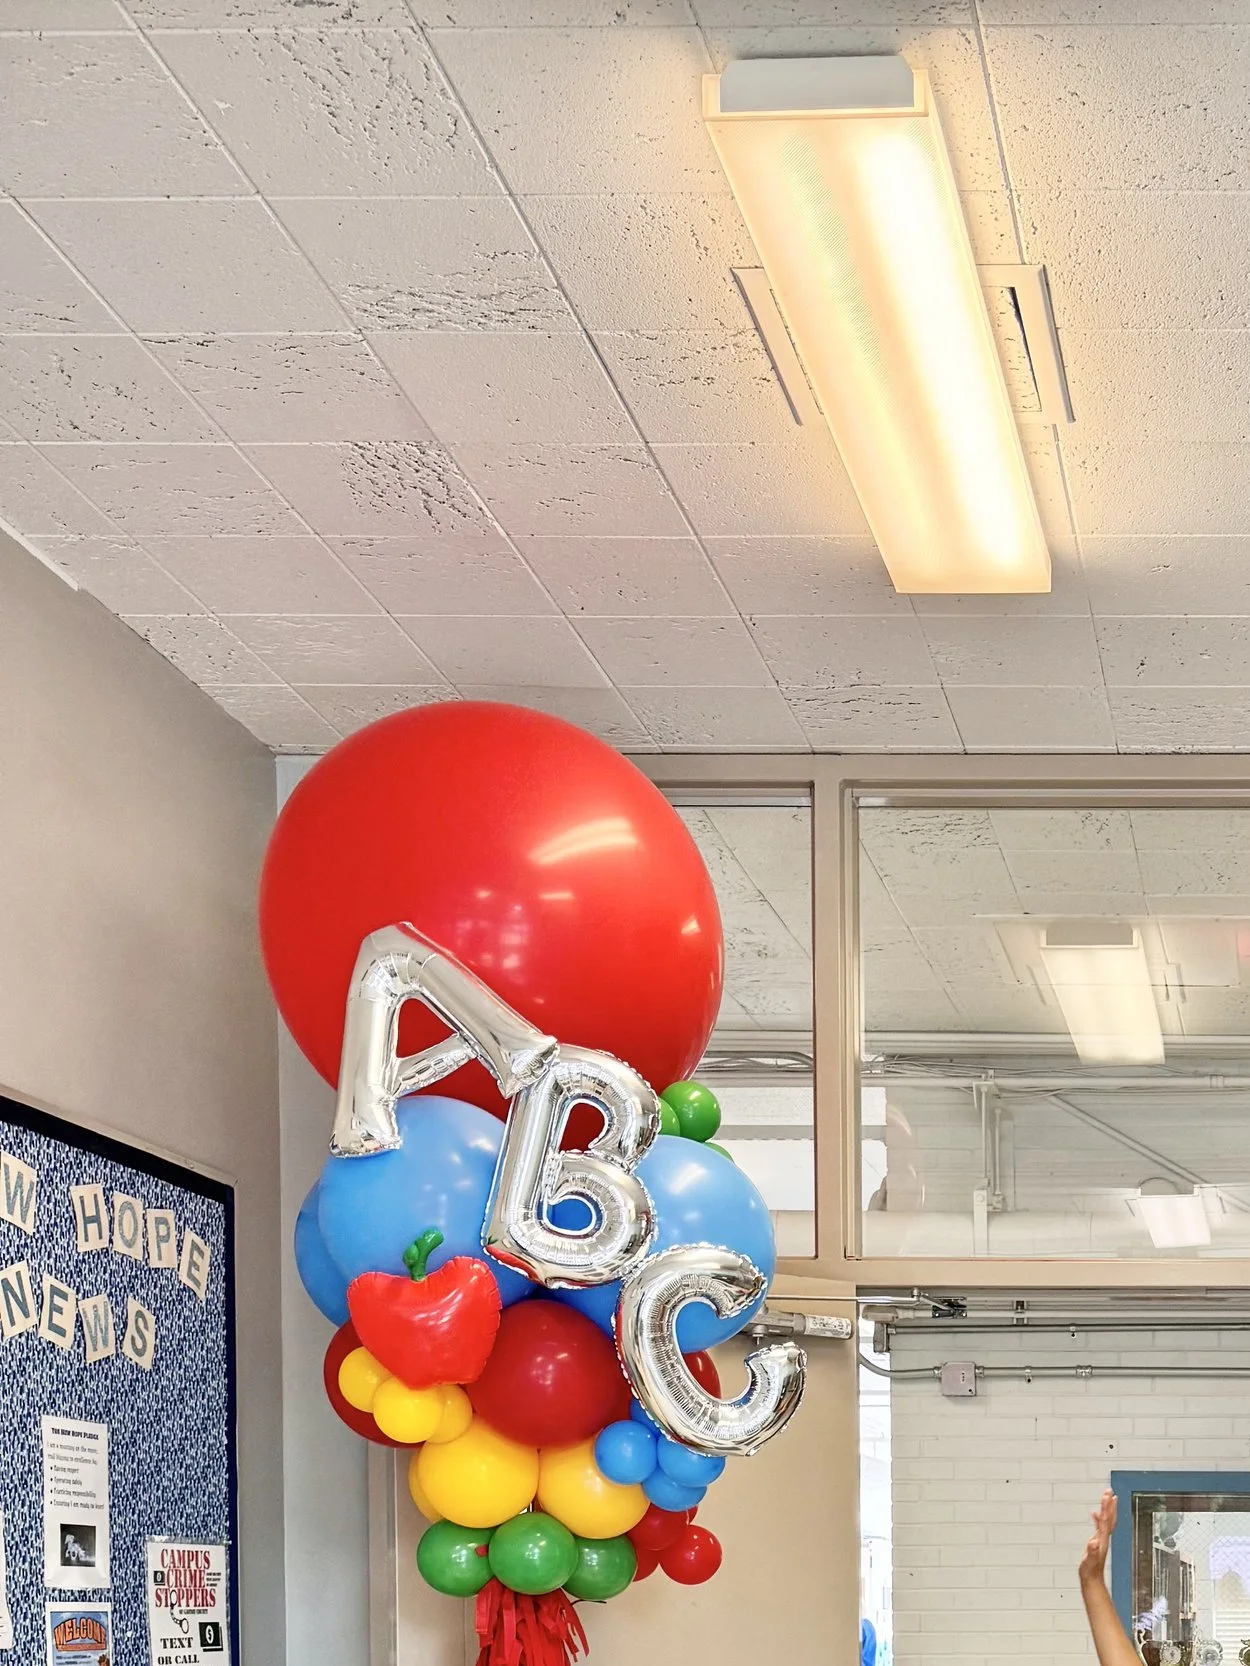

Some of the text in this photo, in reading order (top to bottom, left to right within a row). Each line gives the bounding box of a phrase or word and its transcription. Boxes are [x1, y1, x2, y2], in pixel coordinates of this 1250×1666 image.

[79, 1192, 206, 1291] HOPE
[1, 1270, 149, 1358] NEWS
[160, 1548, 210, 1570] CAMPUS
[166, 1568, 206, 1588] CRIME
[155, 1587, 216, 1608] STOPPERS
[160, 1637, 193, 1649] TEXT
[158, 1654, 199, 1665] OR CALL
